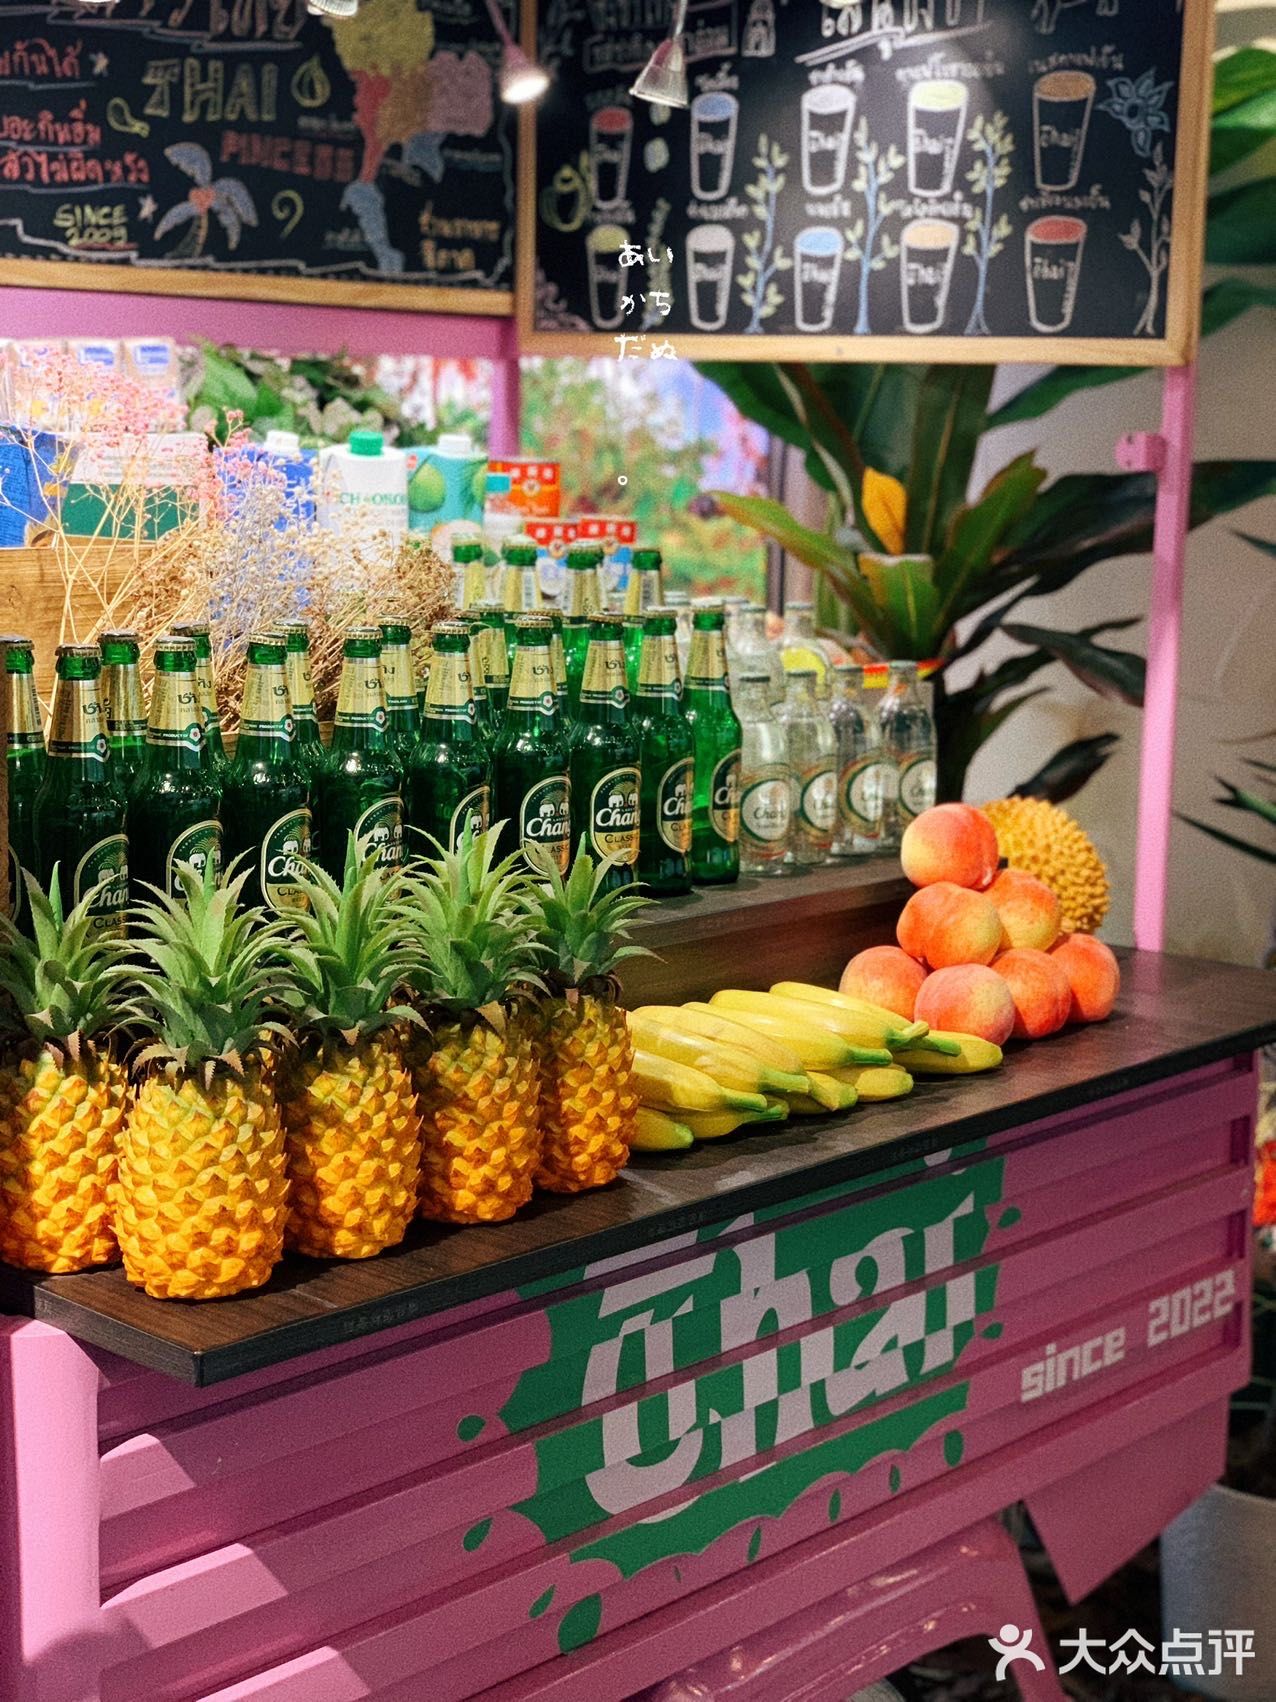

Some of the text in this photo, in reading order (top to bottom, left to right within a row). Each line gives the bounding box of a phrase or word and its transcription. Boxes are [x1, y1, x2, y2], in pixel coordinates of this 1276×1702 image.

[142, 57, 278, 123] THAI
[53, 203, 128, 228] SINCE
[1020, 1268, 1236, 1403] since 2022
